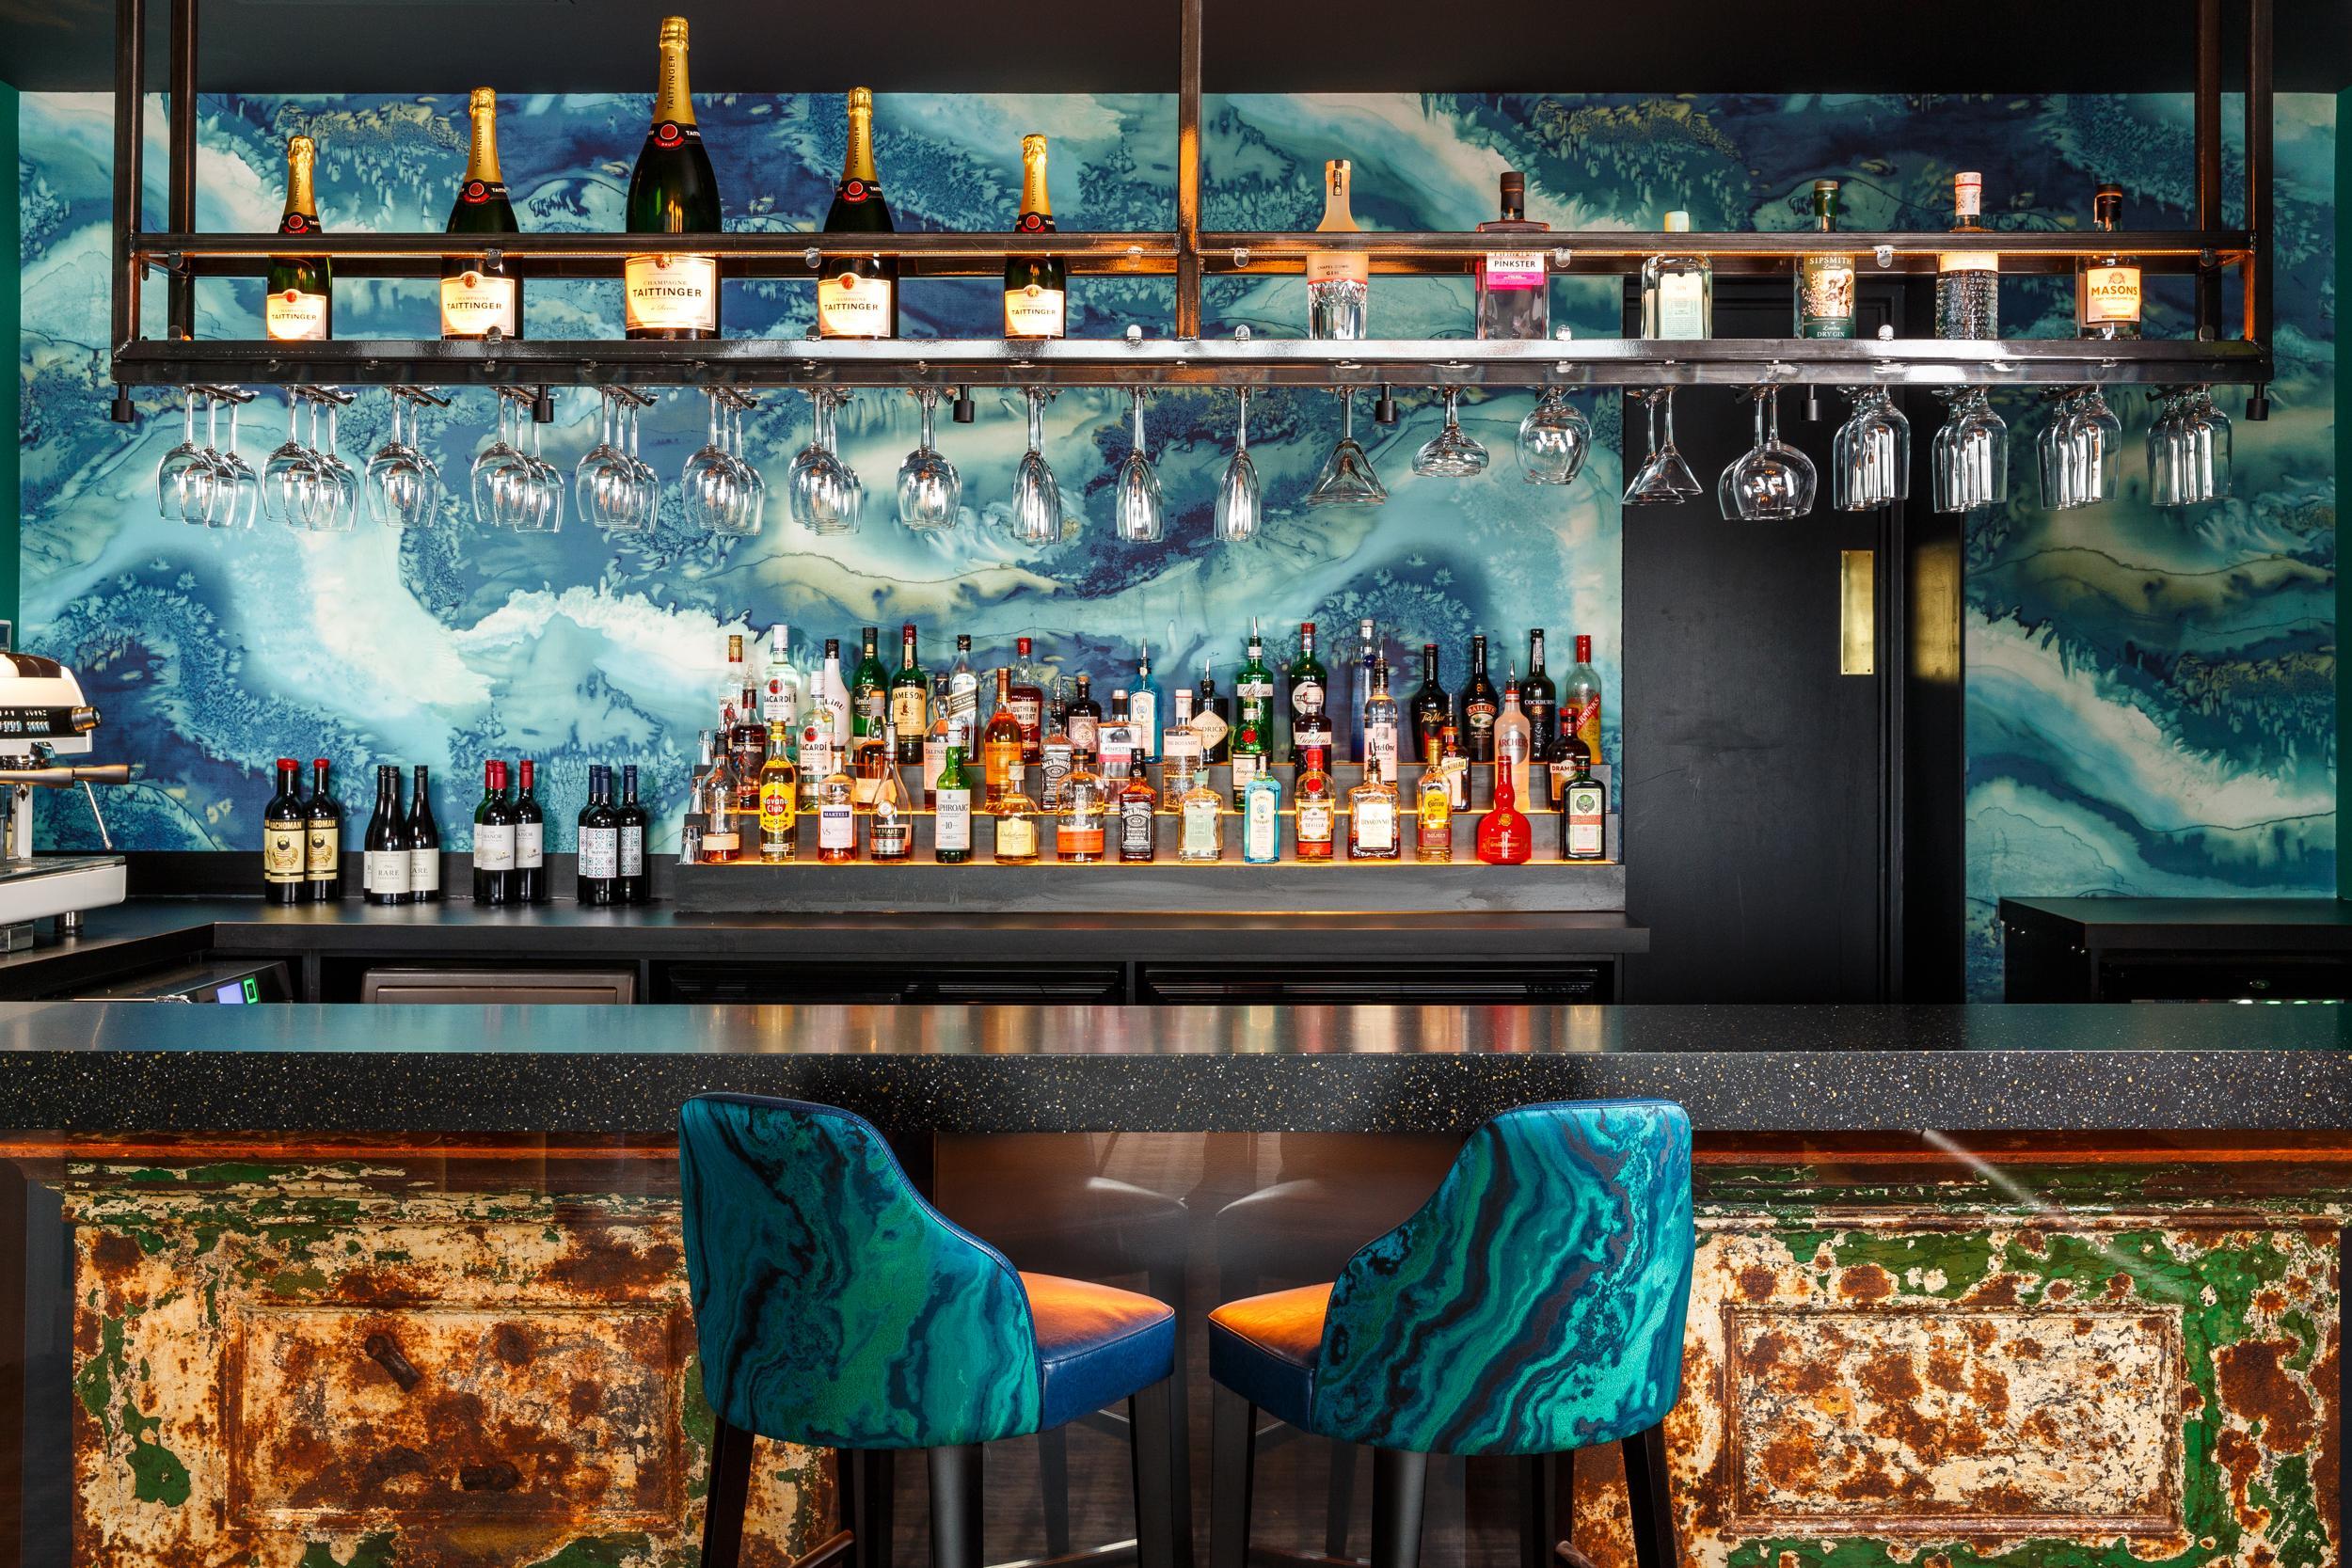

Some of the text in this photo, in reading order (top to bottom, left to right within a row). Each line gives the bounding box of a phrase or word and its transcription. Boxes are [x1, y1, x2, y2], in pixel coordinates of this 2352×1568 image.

[667, 55, 675, 110] TAITTINGER
[1810, 256, 1852, 265] SIPSMITH
[632, 287, 702, 297] TAITTINGER
[2091, 286, 2138, 296] MASONS
[446, 302, 502, 310] TAITTINGER
[824, 302, 879, 311] TAITTINGER
[1468, 705, 1496, 715] BAILEYS
[768, 804, 784, 813] Club
[945, 821, 953, 830] 10
